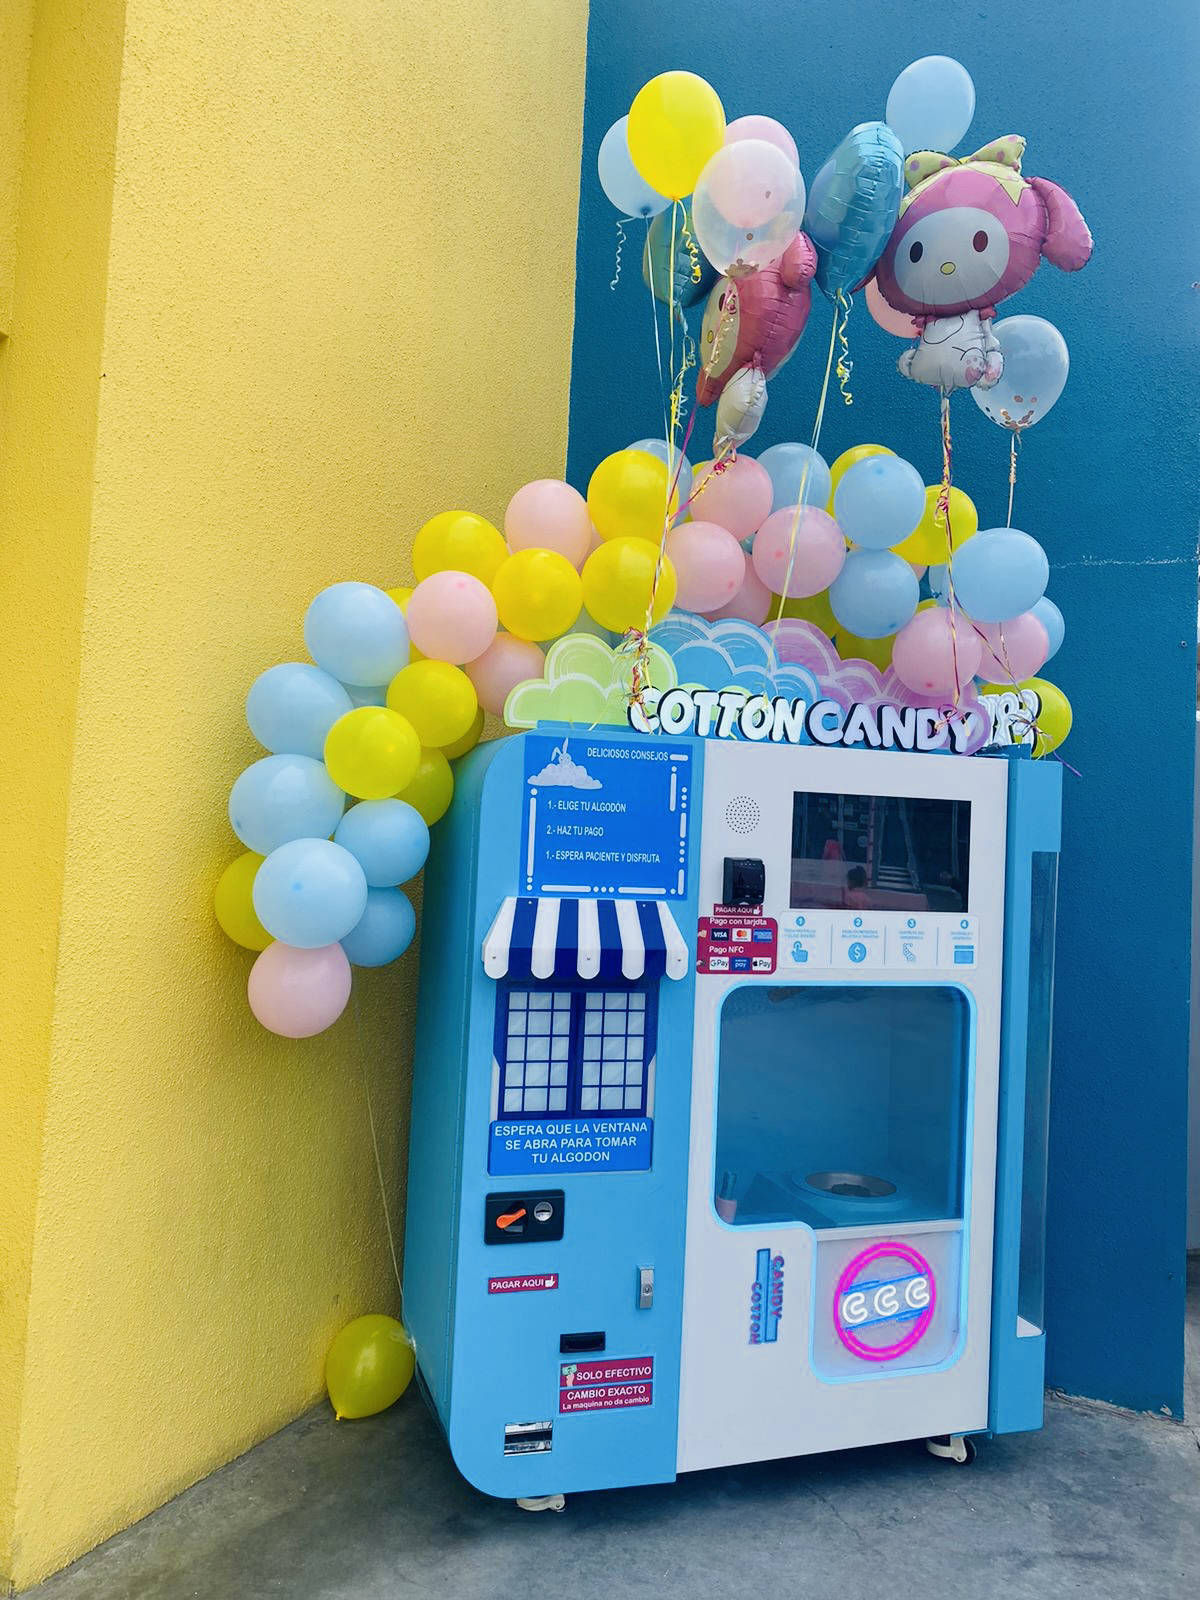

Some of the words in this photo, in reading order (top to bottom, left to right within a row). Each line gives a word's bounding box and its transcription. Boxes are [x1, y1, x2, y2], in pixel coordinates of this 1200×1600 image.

[627, 686, 806, 744] COTTON
[805, 700, 974, 755] CANDY
[588, 748, 630, 758] DELICIOSOS
[631, 750, 668, 760] CONSEJOS
[558, 800, 579, 810] ELIGE
[581, 802, 590, 811] TU
[556, 826, 572, 836] HAZ
[573, 826, 582, 836] TU
[584, 826, 604, 836] PAGO
[556, 850, 584, 860] ESPERA
[586, 852, 619, 862] PACIENTE
[621, 853, 626, 862] Y
[626, 853, 660, 863] DISFRUTA
[710, 918, 727, 926] Pago
[709, 946, 727, 954] Pago
[759, 960, 770, 968] Pay
[495, 1125, 542, 1136] ESPERA
[546, 1124, 572, 1135] QUE
[575, 1124, 589, 1134] LA
[593, 1122, 648, 1133] VENTANA
[506, 1140, 520, 1150] SE
[524, 1138, 558, 1150] ABRA
[561, 1138, 592, 1148] PARA
[595, 1136, 637, 1147] TOMAR
[532, 1153, 548, 1163] TU
[551, 1152, 610, 1163] ALGODON
[491, 1279, 520, 1290] PAGAR
[522, 1278, 544, 1288] AQUI
[772, 1256, 784, 1320] CANDY
[750, 1282, 762, 1344] COTTON
[576, 1370, 602, 1380] SOLO
[605, 1367, 652, 1378] EFECTIVO
[567, 1389, 606, 1400] CAMBIO
[608, 1386, 646, 1396] EXACTO
[573, 1401, 602, 1409] maquina
